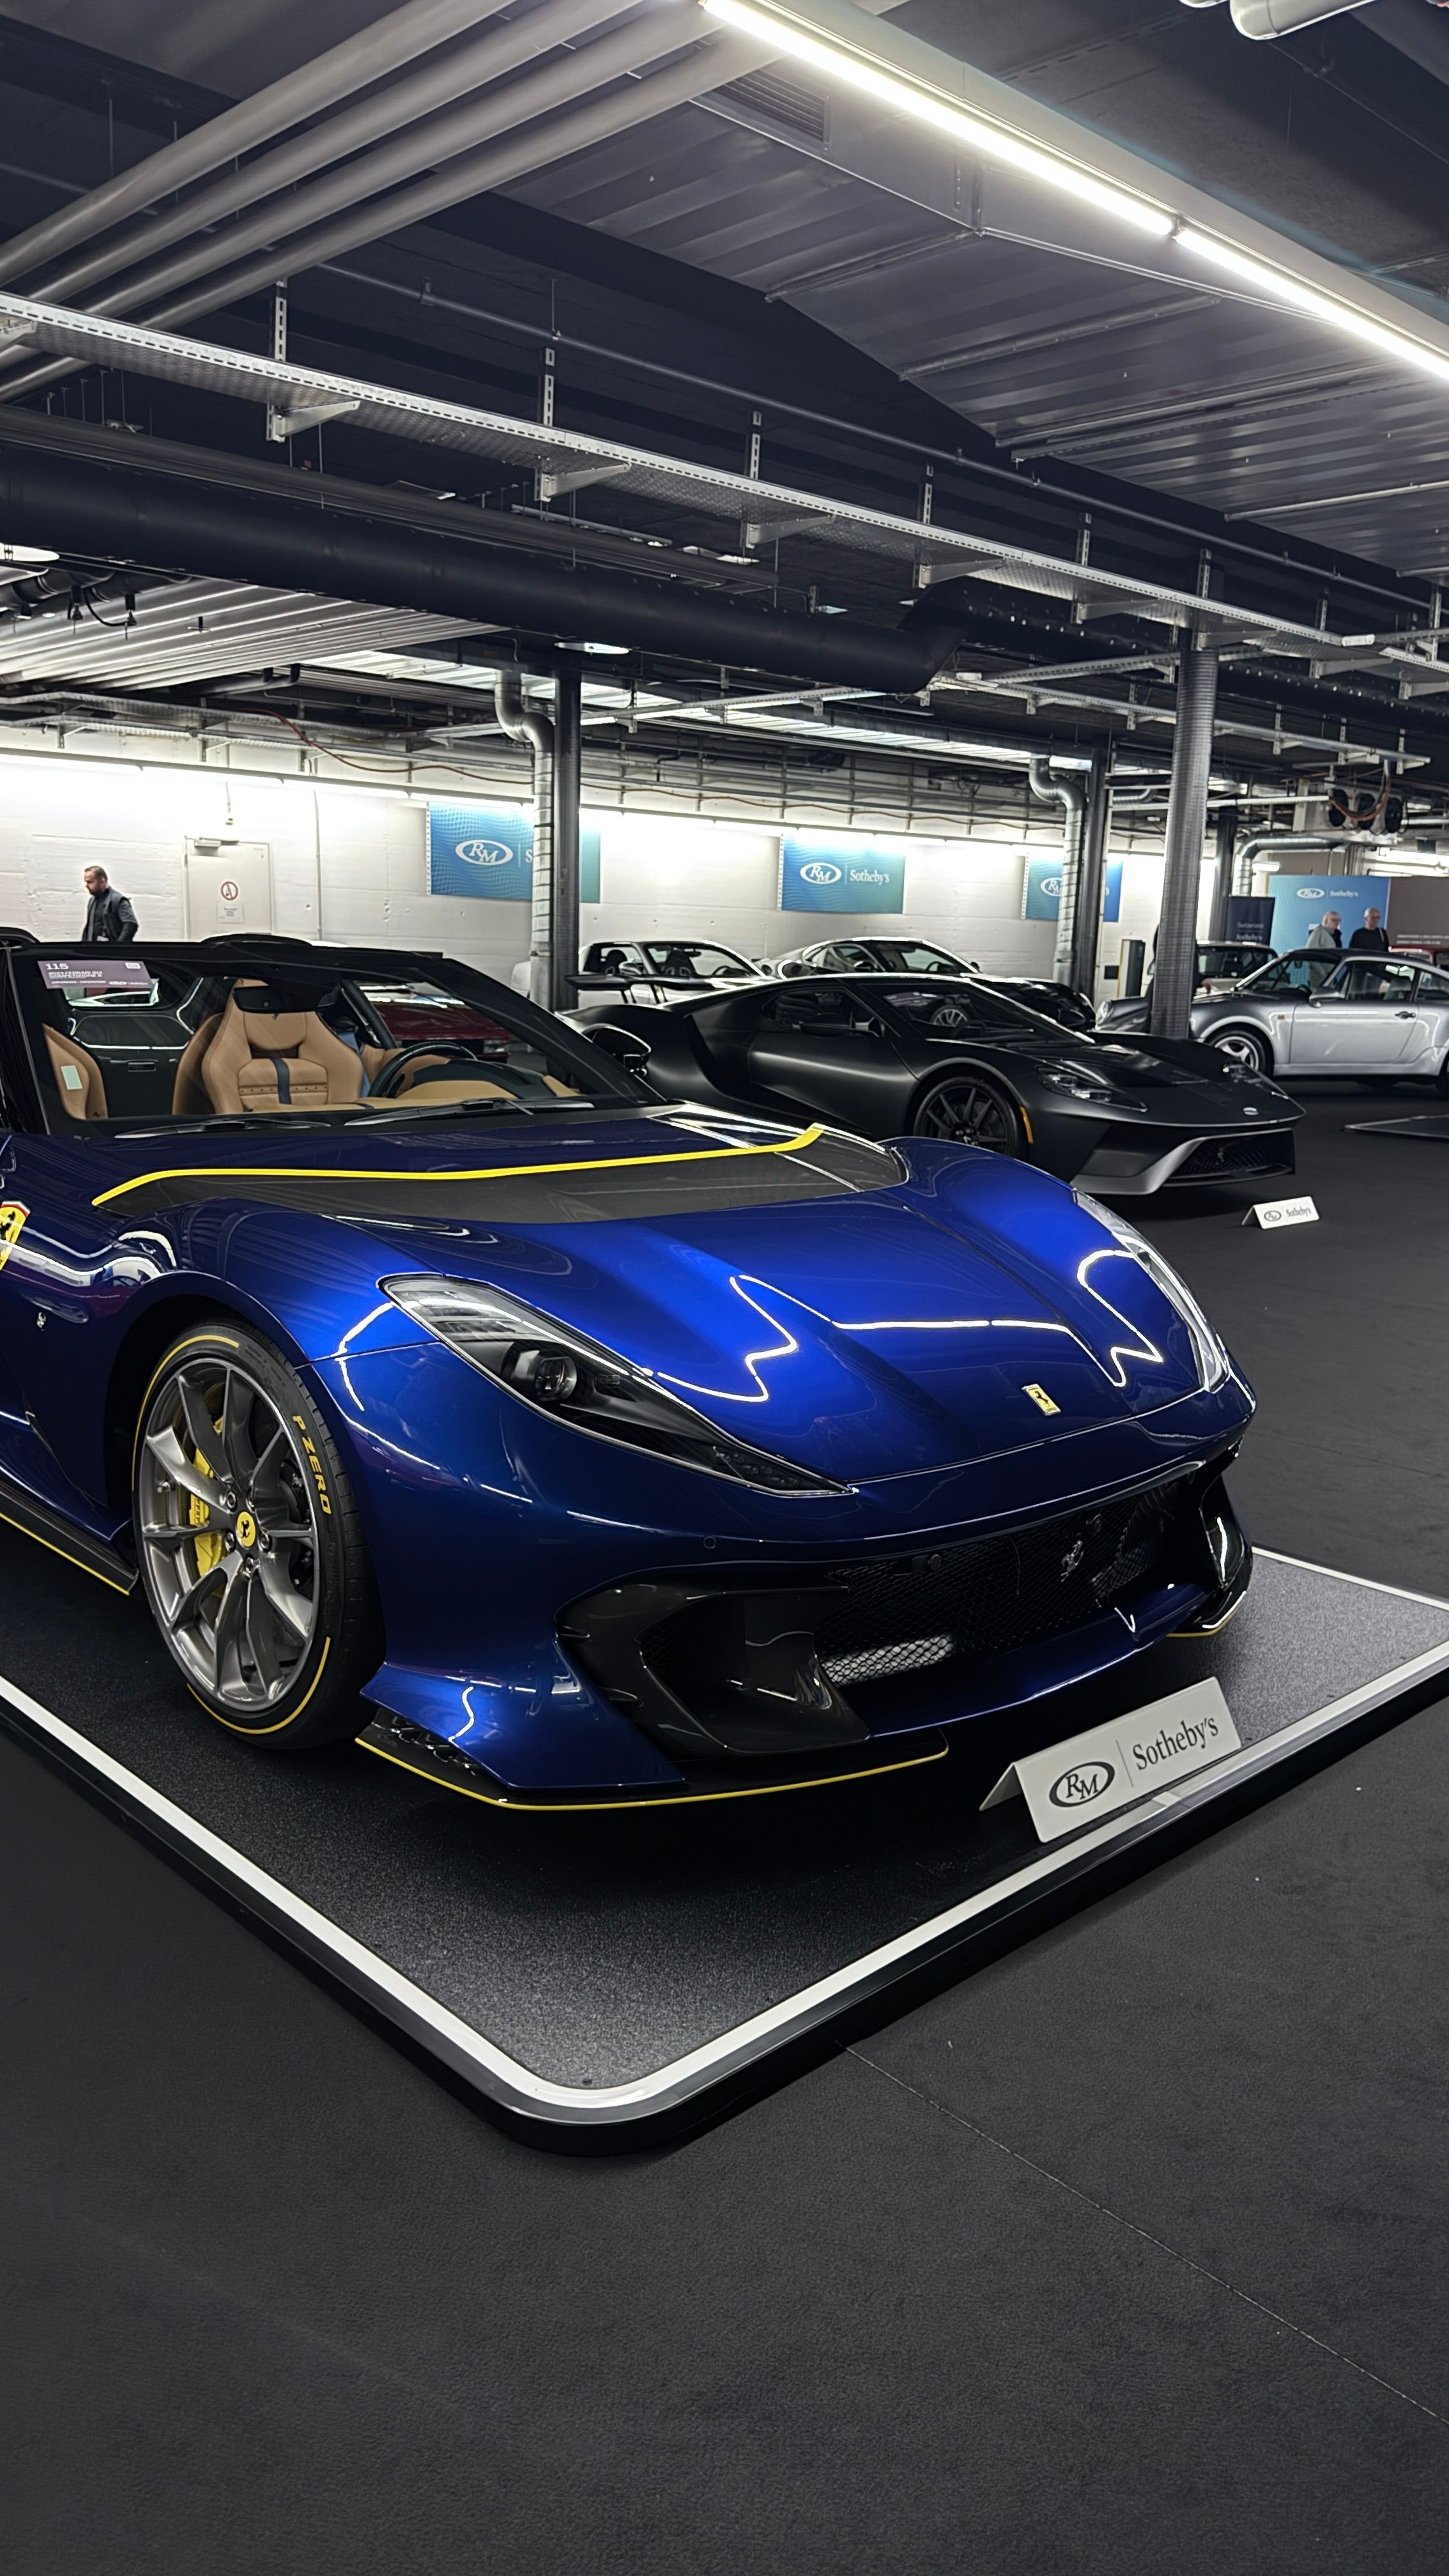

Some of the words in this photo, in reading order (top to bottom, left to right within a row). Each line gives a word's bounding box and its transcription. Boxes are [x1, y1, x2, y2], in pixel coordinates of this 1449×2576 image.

[469, 843, 498, 862] RM
[809, 865, 831, 882] RM
[850, 869, 890, 885] Sotheby's
[292, 1415, 306, 1430] P
[302, 1437, 332, 1515] ZERO
[1065, 1773, 1099, 1800] RM
[1132, 1717, 1218, 1771] Sotheby's
